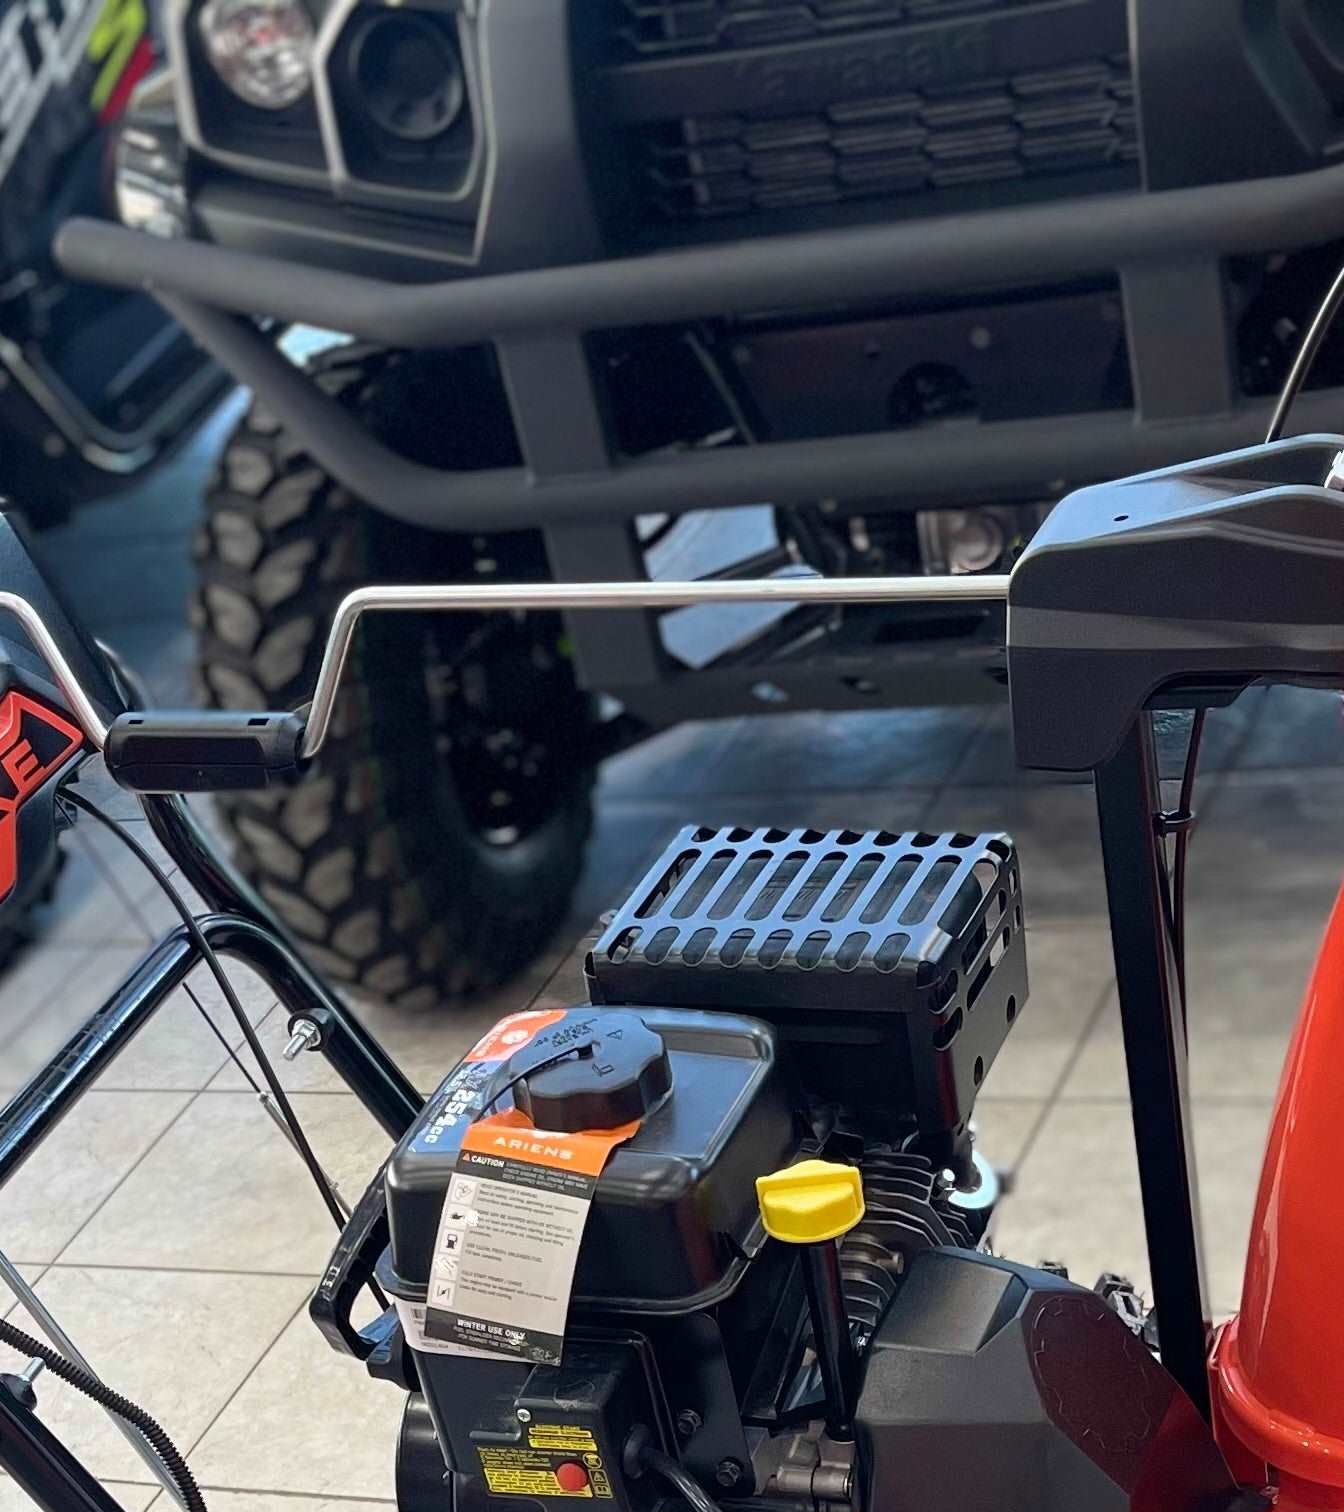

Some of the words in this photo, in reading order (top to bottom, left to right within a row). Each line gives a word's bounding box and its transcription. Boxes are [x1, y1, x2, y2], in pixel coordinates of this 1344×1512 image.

[494, 1136, 574, 1160] ARIENS
[471, 1155, 505, 1168] CAUTION
[457, 1318, 487, 1333] WINTER
[487, 1325, 504, 1335] USE
